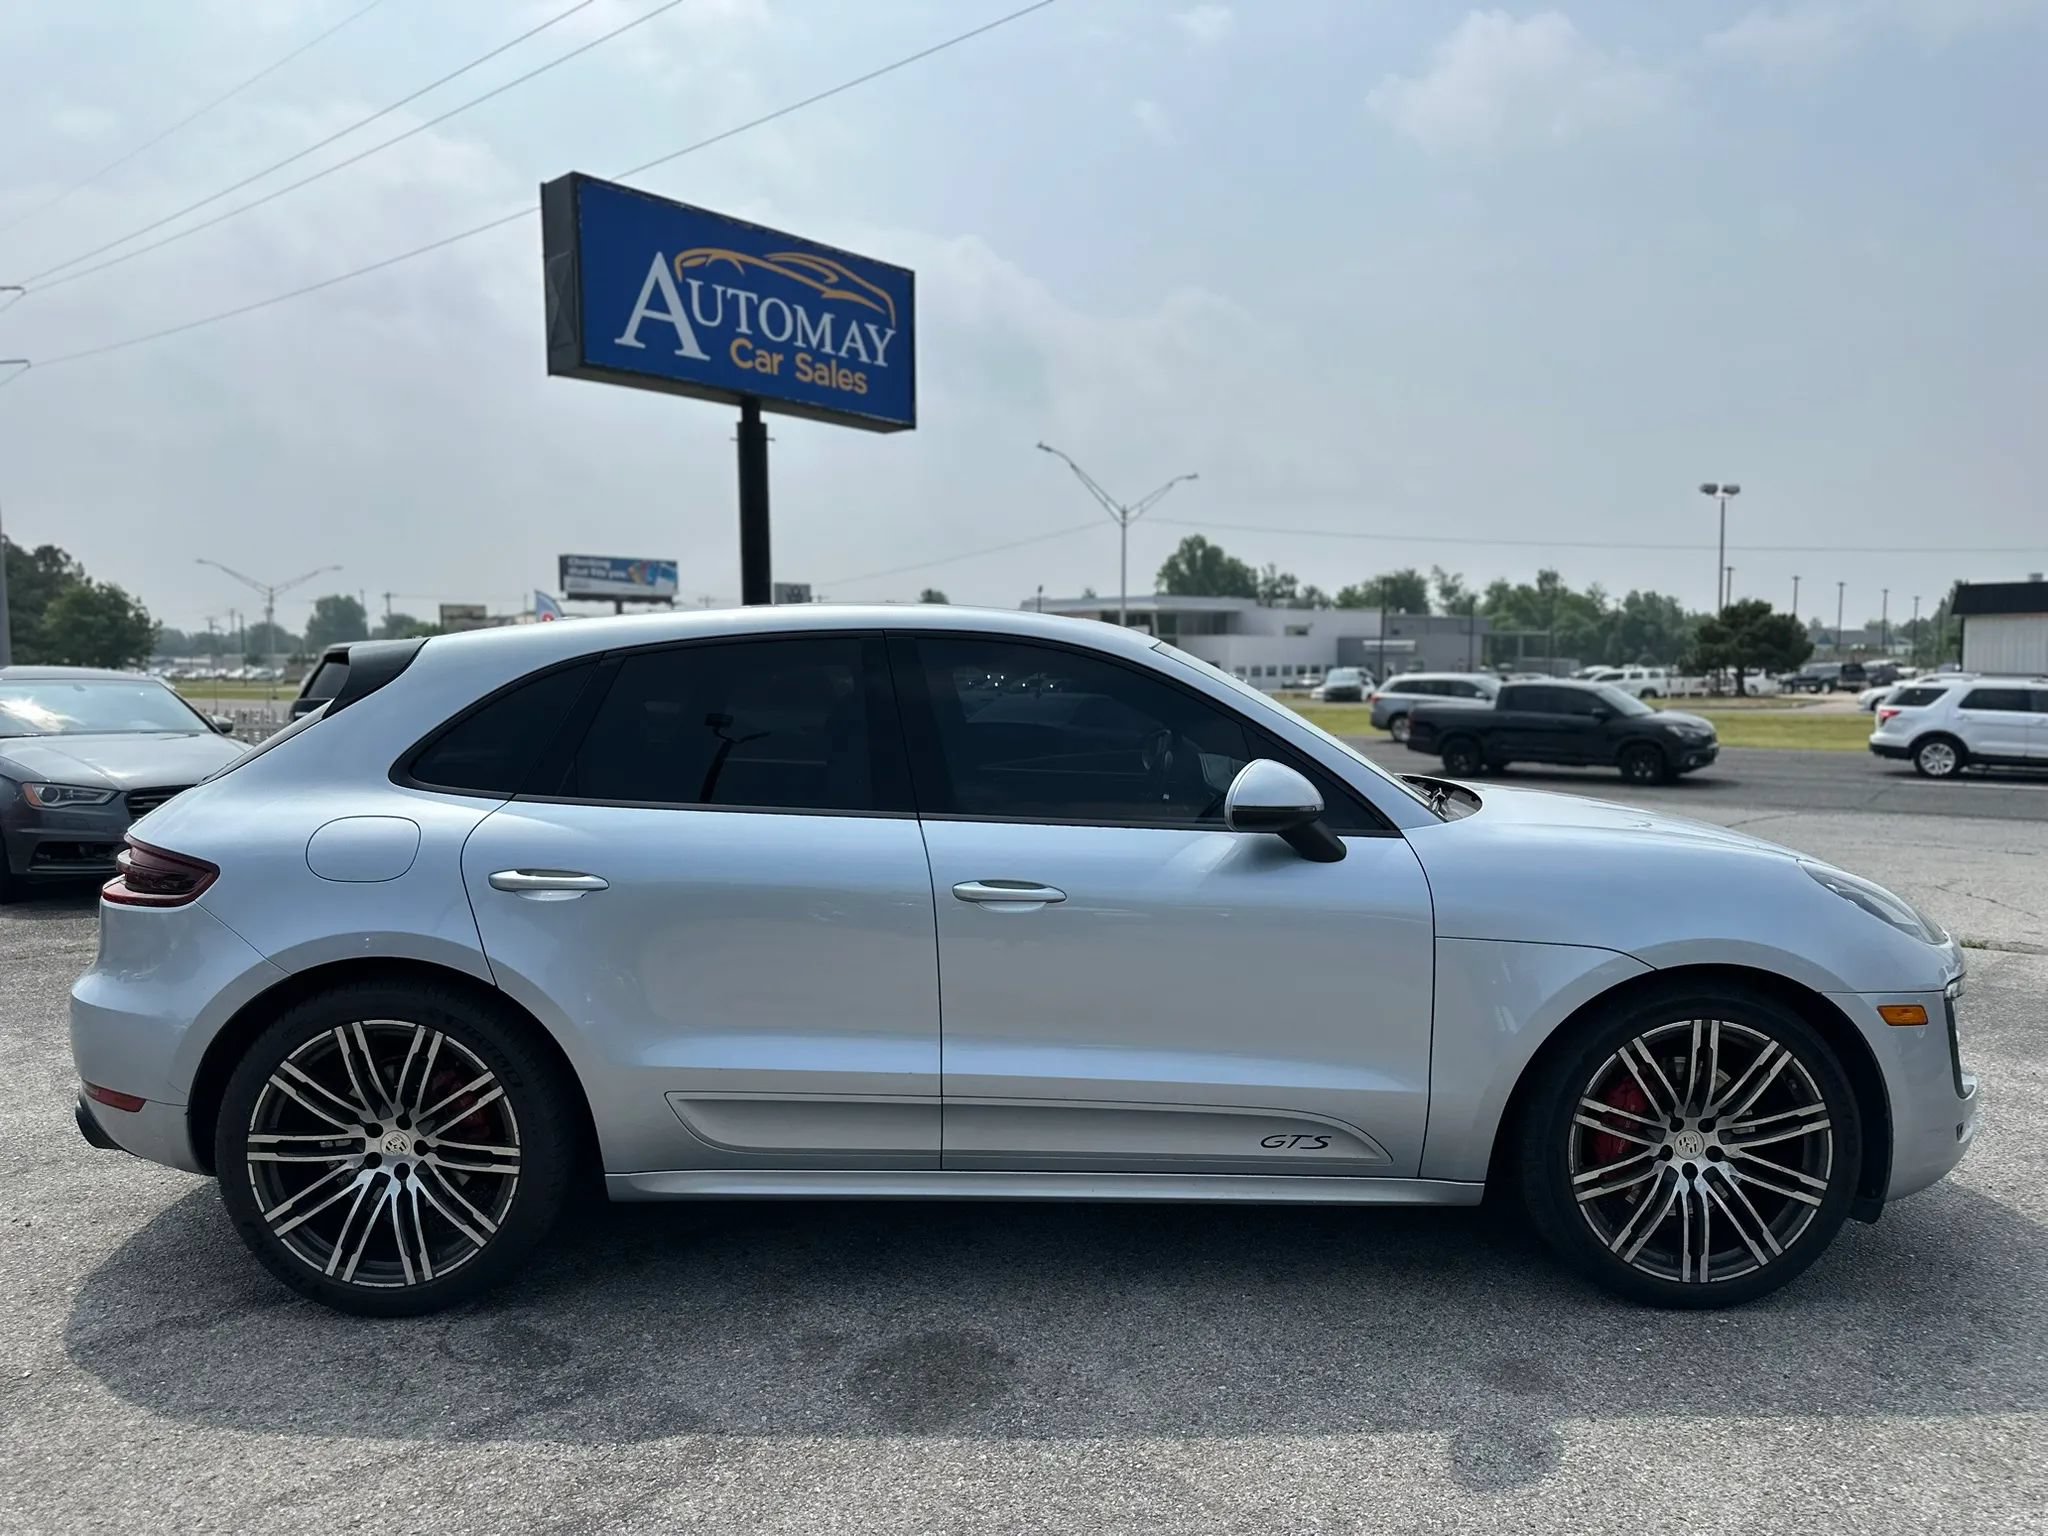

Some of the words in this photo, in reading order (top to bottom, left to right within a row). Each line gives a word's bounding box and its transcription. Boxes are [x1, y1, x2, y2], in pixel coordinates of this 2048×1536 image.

[614, 250, 896, 367] AUTOMAY
[729, 338, 783, 376] Car
[795, 351, 868, 395] Sales
[1260, 1134, 1333, 1150] GTS
